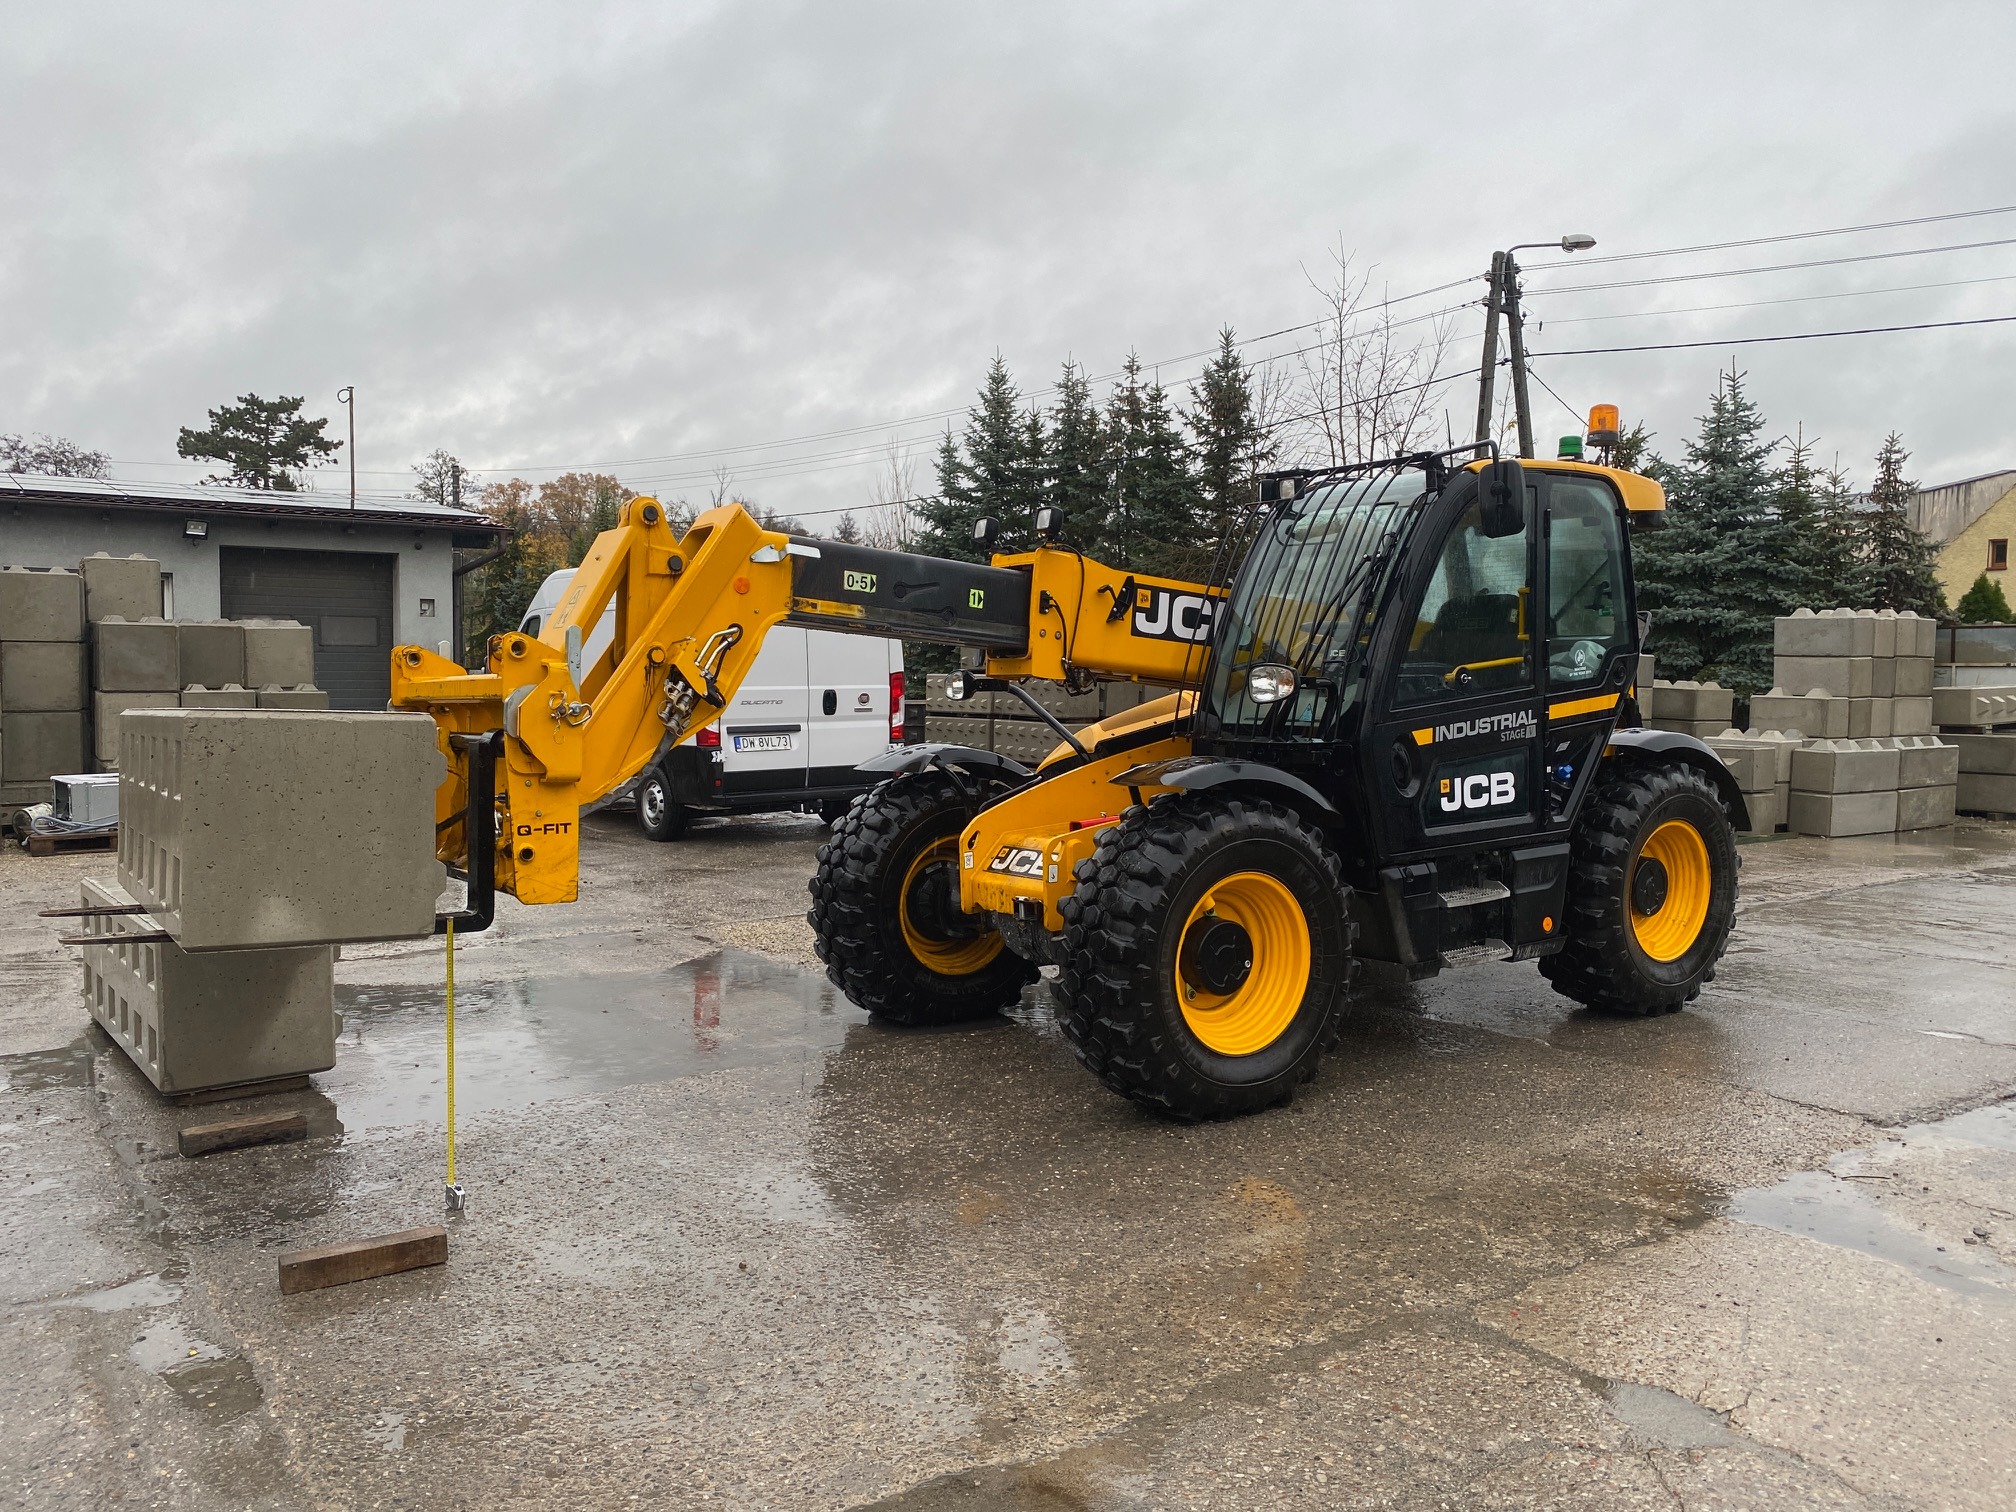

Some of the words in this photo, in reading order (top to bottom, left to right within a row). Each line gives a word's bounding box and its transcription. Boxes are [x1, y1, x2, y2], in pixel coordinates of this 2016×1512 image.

[970, 592, 977, 606] 1
[1136, 592, 1226, 641] JC
[1435, 709, 1538, 743] INDUSTRIAL
[741, 737, 756, 749] DW
[758, 736, 788, 748] 8VL73
[1500, 728, 1526, 742] STAGE
[1441, 771, 1516, 812] JCB
[517, 822, 572, 837] Q-FIT
